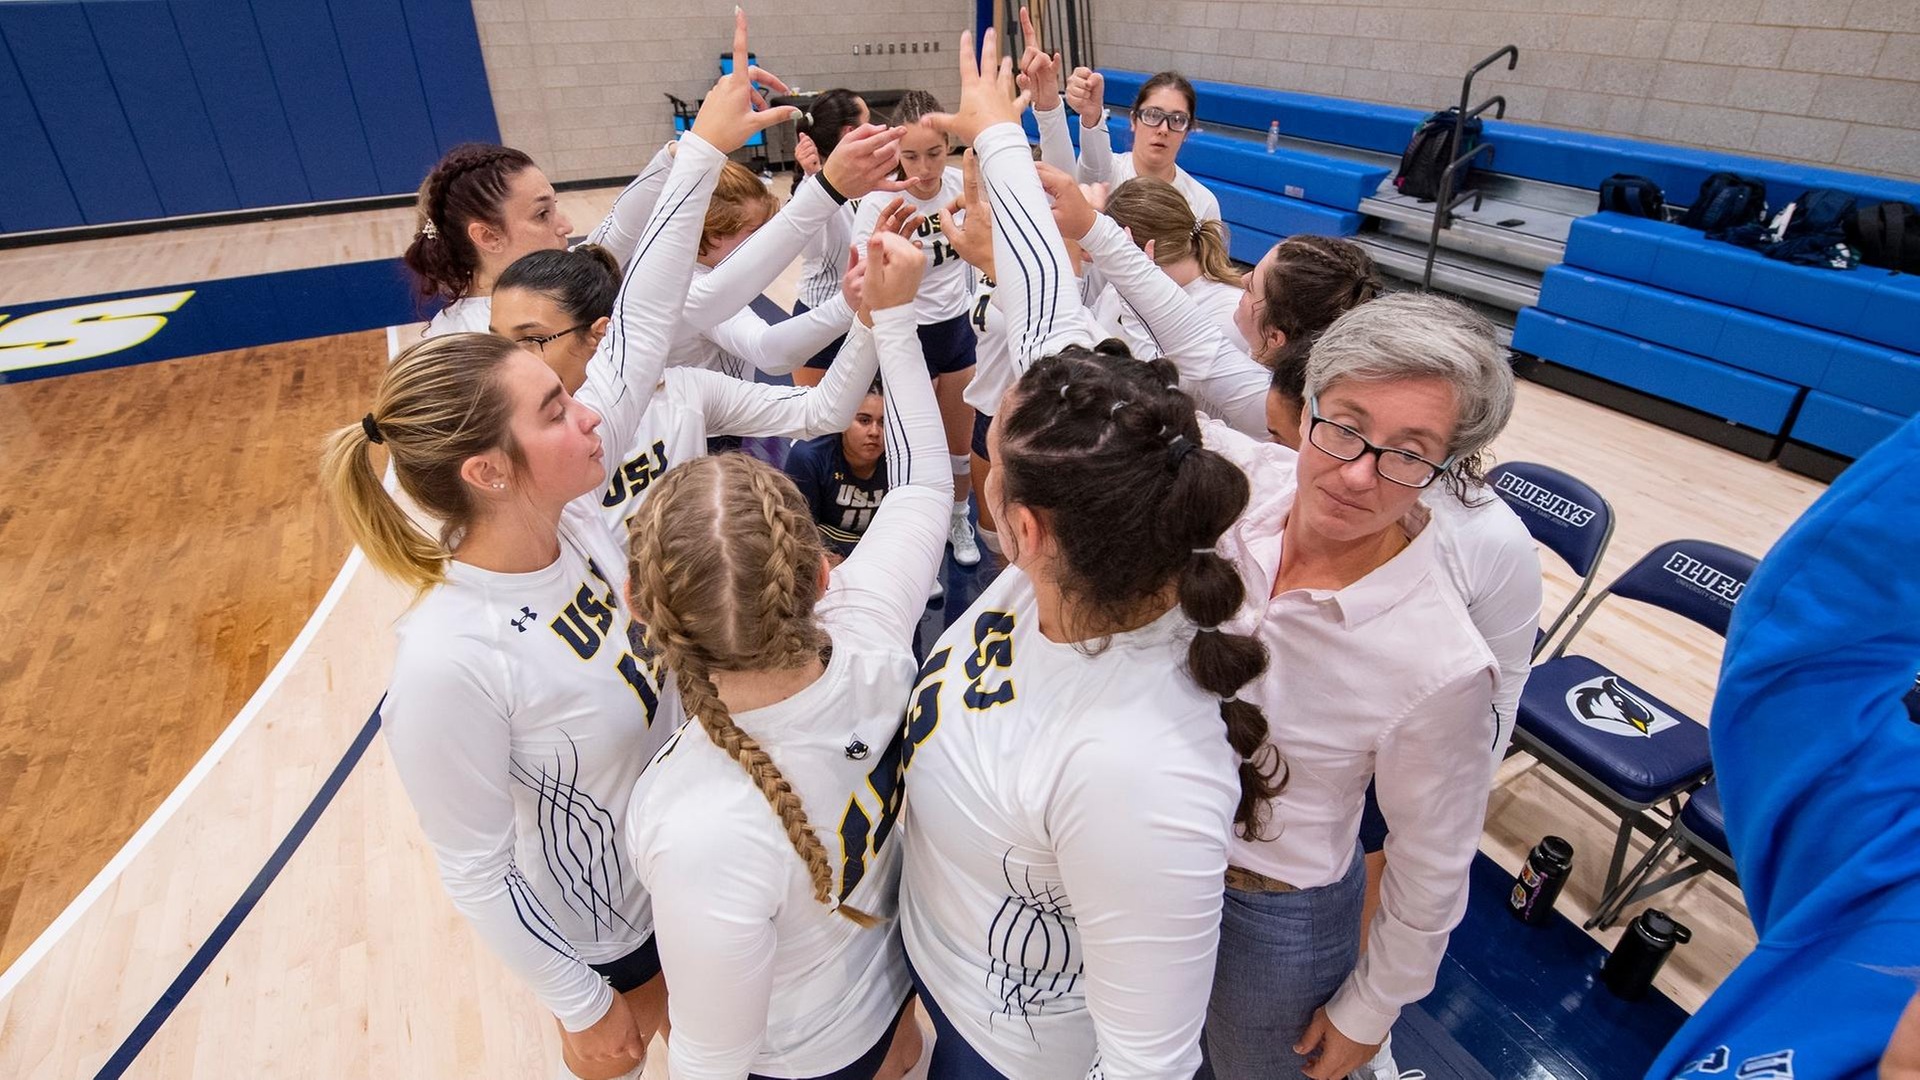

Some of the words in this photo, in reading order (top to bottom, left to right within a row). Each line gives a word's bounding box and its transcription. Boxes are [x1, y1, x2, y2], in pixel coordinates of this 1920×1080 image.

[917, 212, 942, 238] US
[0, 290, 196, 373] S
[602, 439, 668, 508] USJ
[835, 483, 884, 508] USJ
[1495, 471, 1596, 528] BLUEJAYS
[840, 509, 872, 532] 11
[1663, 551, 1746, 604] BLUEJ
[963, 611, 1017, 712] USJ
